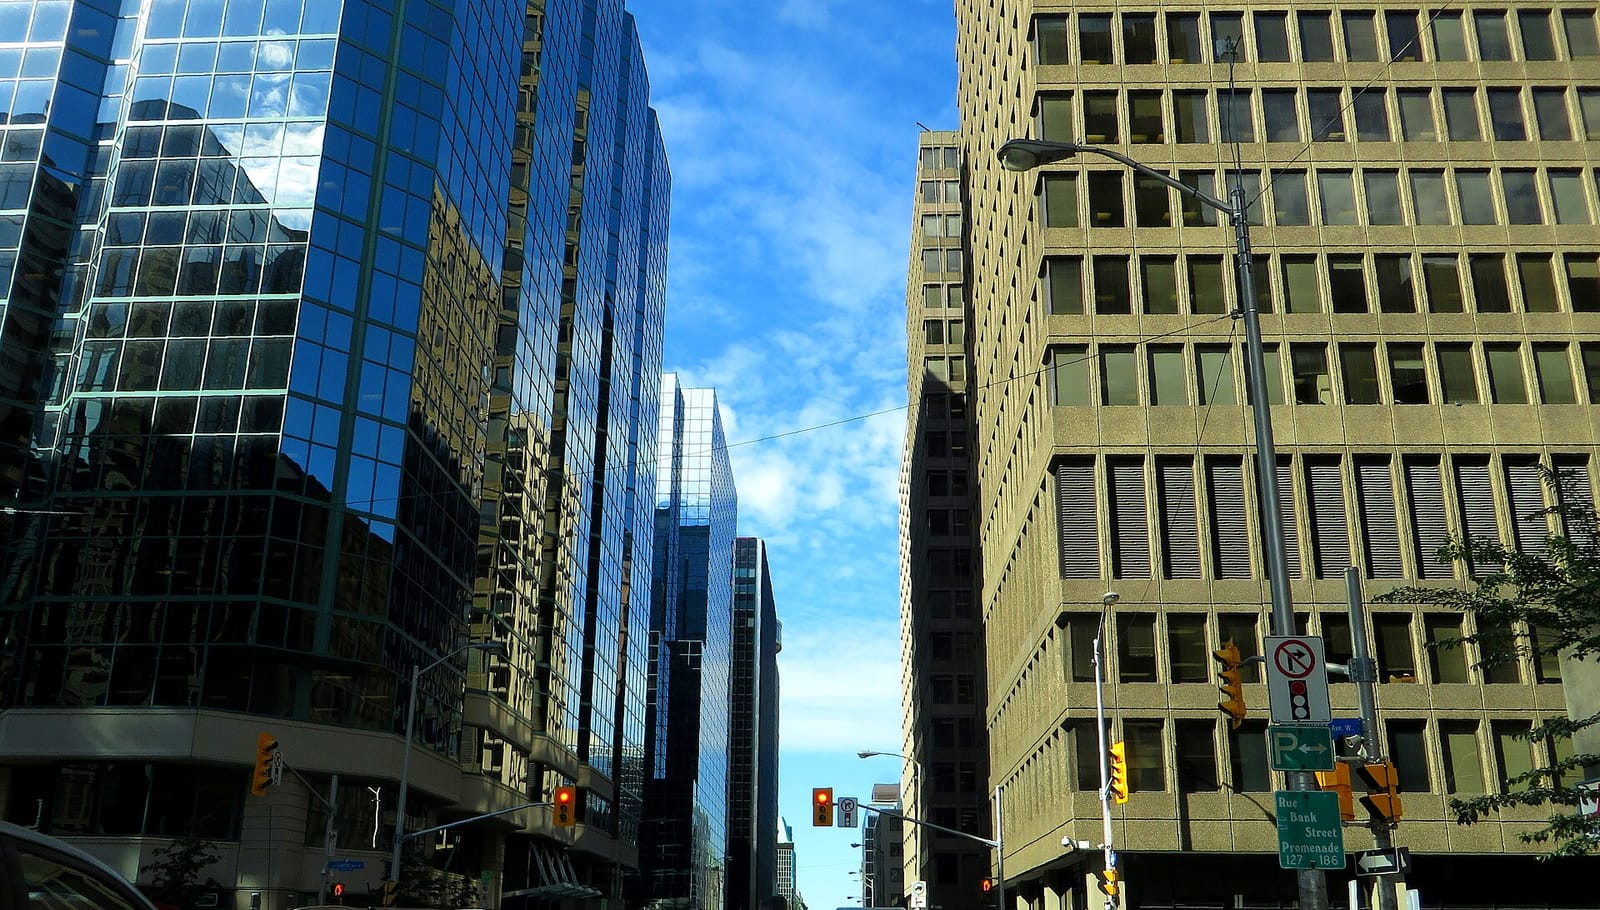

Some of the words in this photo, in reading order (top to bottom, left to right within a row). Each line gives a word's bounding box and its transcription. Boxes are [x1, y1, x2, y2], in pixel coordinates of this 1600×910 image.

[1273, 731, 1298, 765] P
[1278, 797, 1298, 808] Rue
[1290, 811, 1317, 823] Bank
[1305, 826, 1338, 838] Street
[1281, 841, 1339, 853] Promenade
[1286, 854, 1303, 865] 127
[1319, 854, 1339, 866] 186
